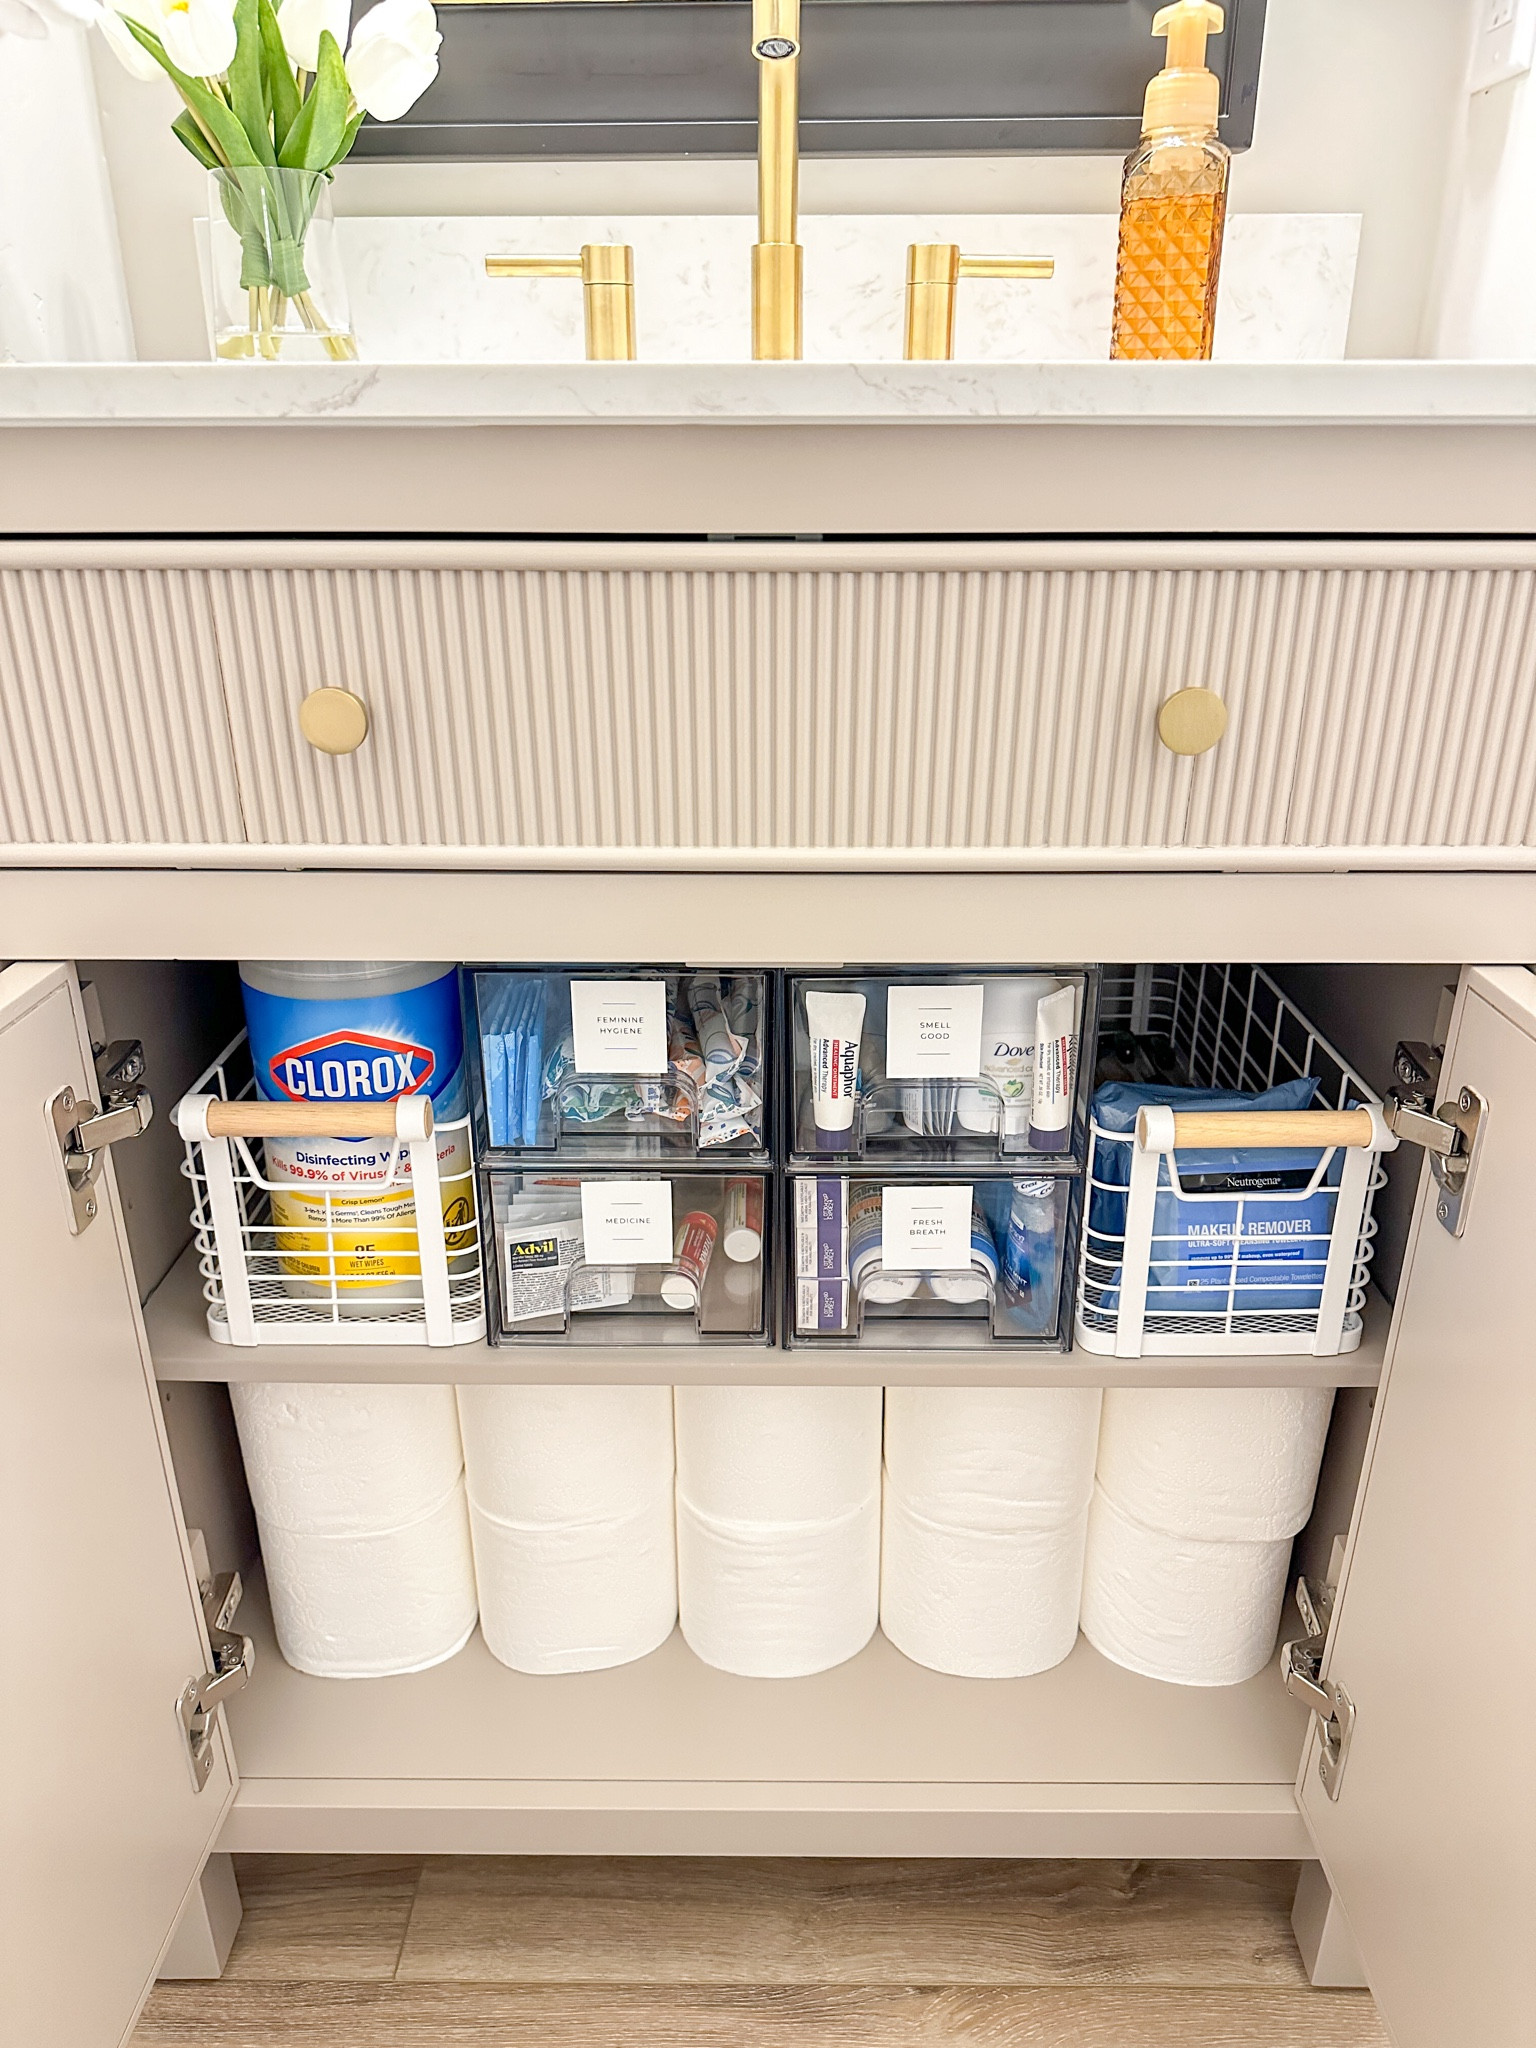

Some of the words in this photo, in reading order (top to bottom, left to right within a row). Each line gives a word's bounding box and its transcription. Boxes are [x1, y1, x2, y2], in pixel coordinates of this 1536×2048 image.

[994, 1042, 1034, 1057] Dove
[285, 1050, 417, 1098] CLOROX
[839, 1040, 858, 1098] Aquaphor
[296, 1152, 376, 1166] Disinfecting
[272, 1156, 288, 1172] Kills
[289, 1164, 328, 1180] 99.9%
[332, 1171, 345, 1181] of
[1021, 1181, 1037, 1189] Crest
[383, 1205, 402, 1213] Tough
[1248, 1219, 1311, 1235] REMOVER
[512, 1240, 554, 1257] Advil
[349, 1260, 363, 1268] WET
[364, 1258, 384, 1267] WIPES
[1250, 1275, 1289, 1284] Compostable
